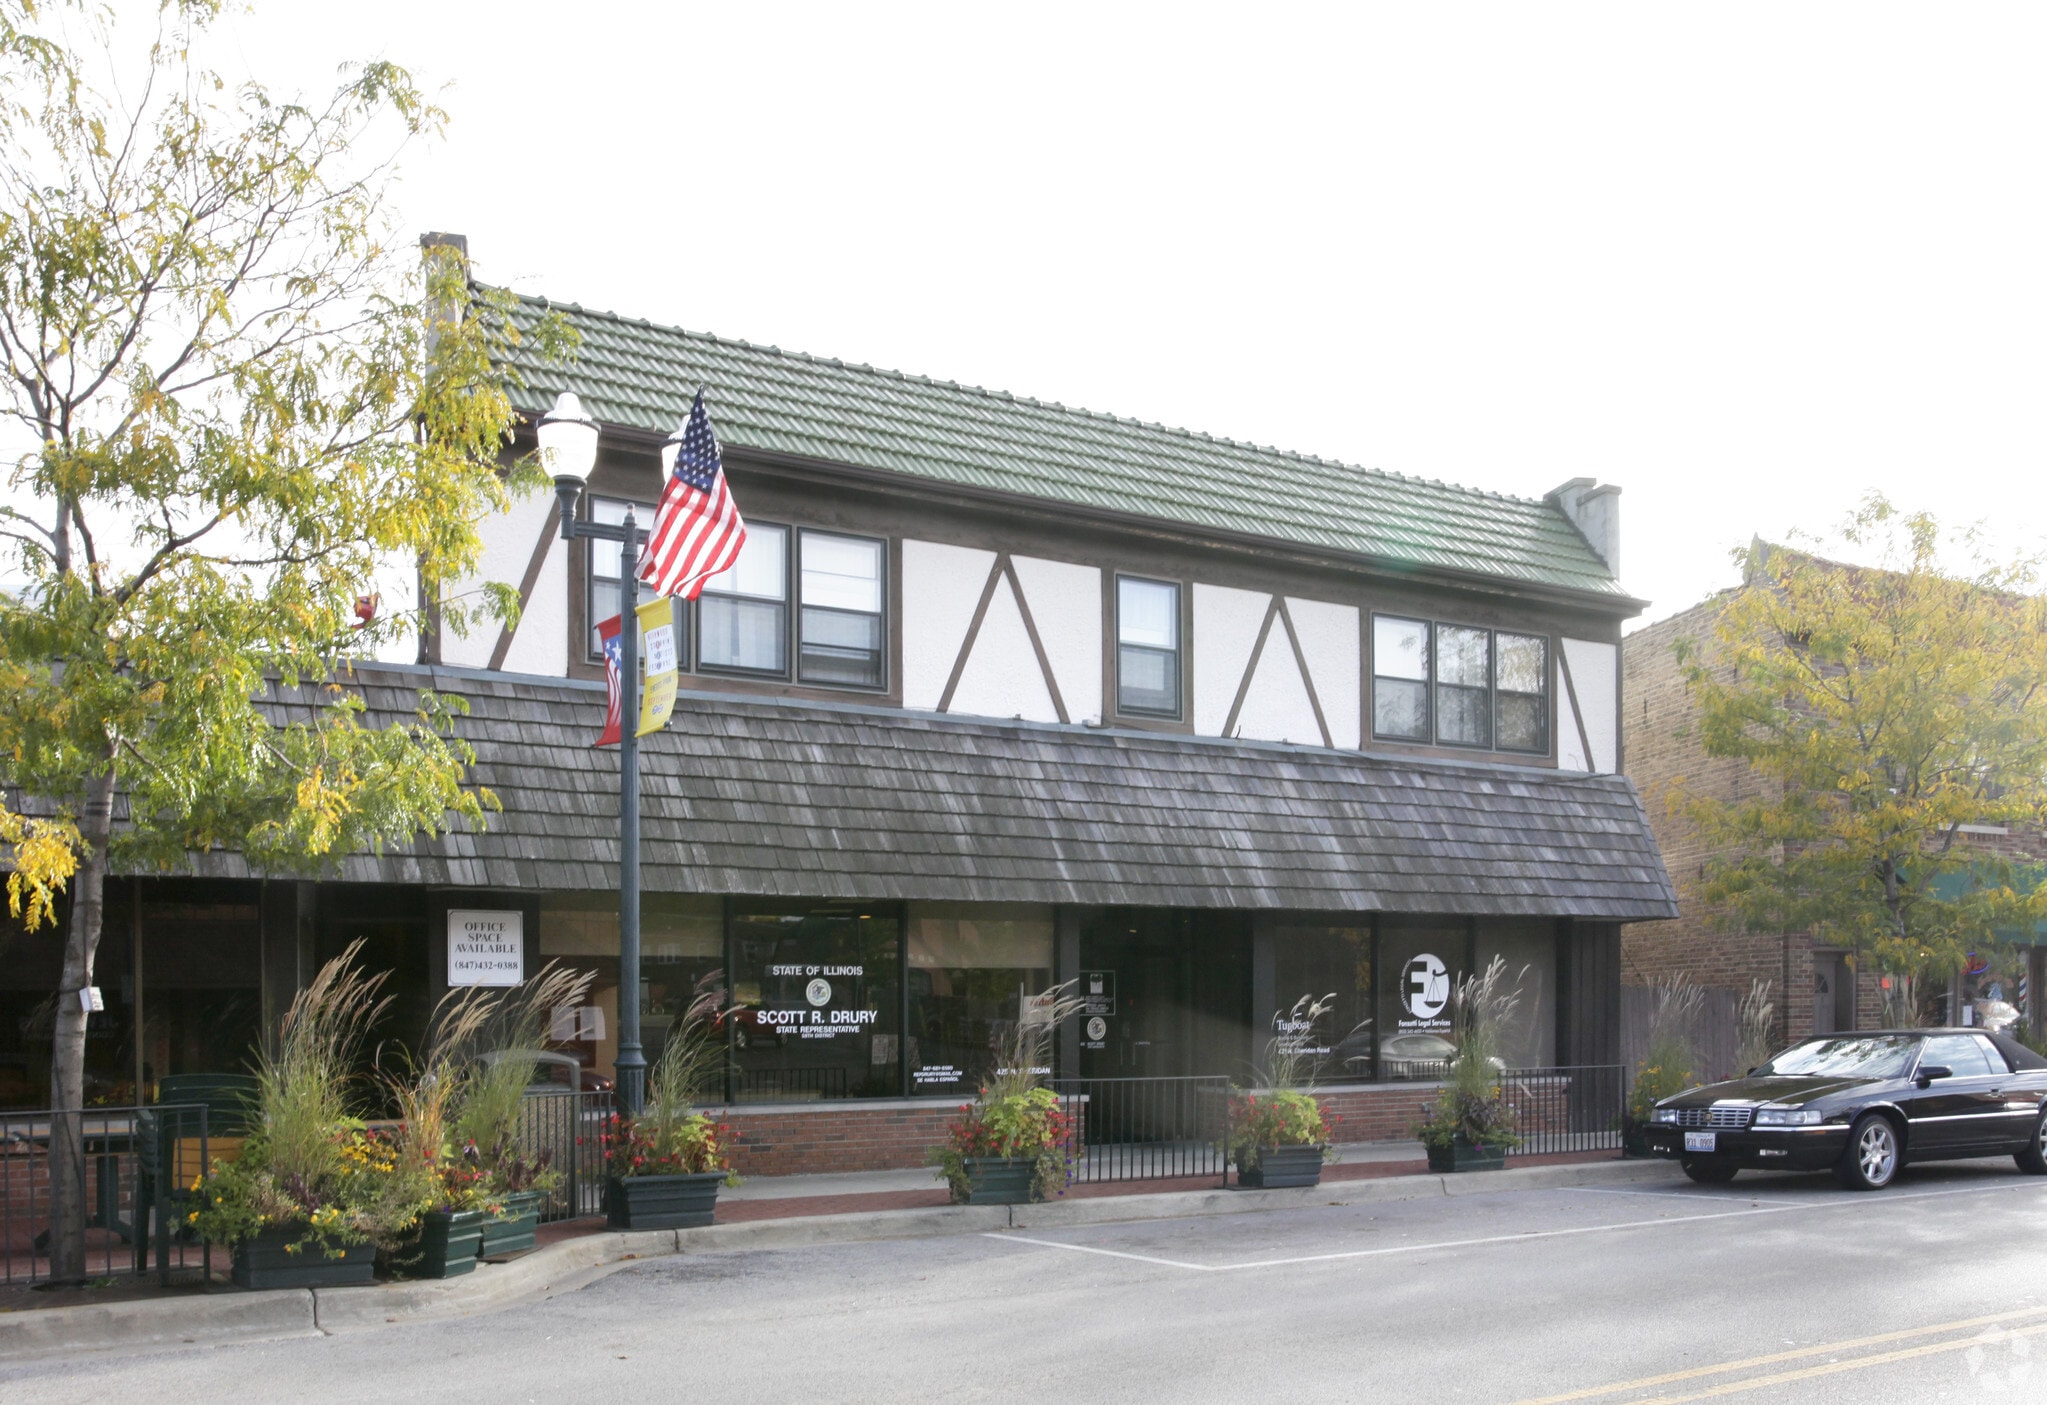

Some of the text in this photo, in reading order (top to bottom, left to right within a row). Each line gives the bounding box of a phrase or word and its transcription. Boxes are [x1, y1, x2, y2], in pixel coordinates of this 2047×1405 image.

[464, 921, 506, 932] OFFICE
[468, 932, 503, 942] SPACE
[455, 944, 517, 953] AVAILABLE
[454, 960, 518, 970] (847)432-0388
[772, 965, 863, 976] STATE OF ILLINOIS
[757, 1010, 878, 1024] SCOTT R. DRURY
[1276, 1019, 1311, 1033] Tugboat
[1418, 1019, 1430, 1028] Legal
[1432, 1019, 1451, 1027] Services
[776, 1025, 860, 1034] STATE REPRESENTATIVE
